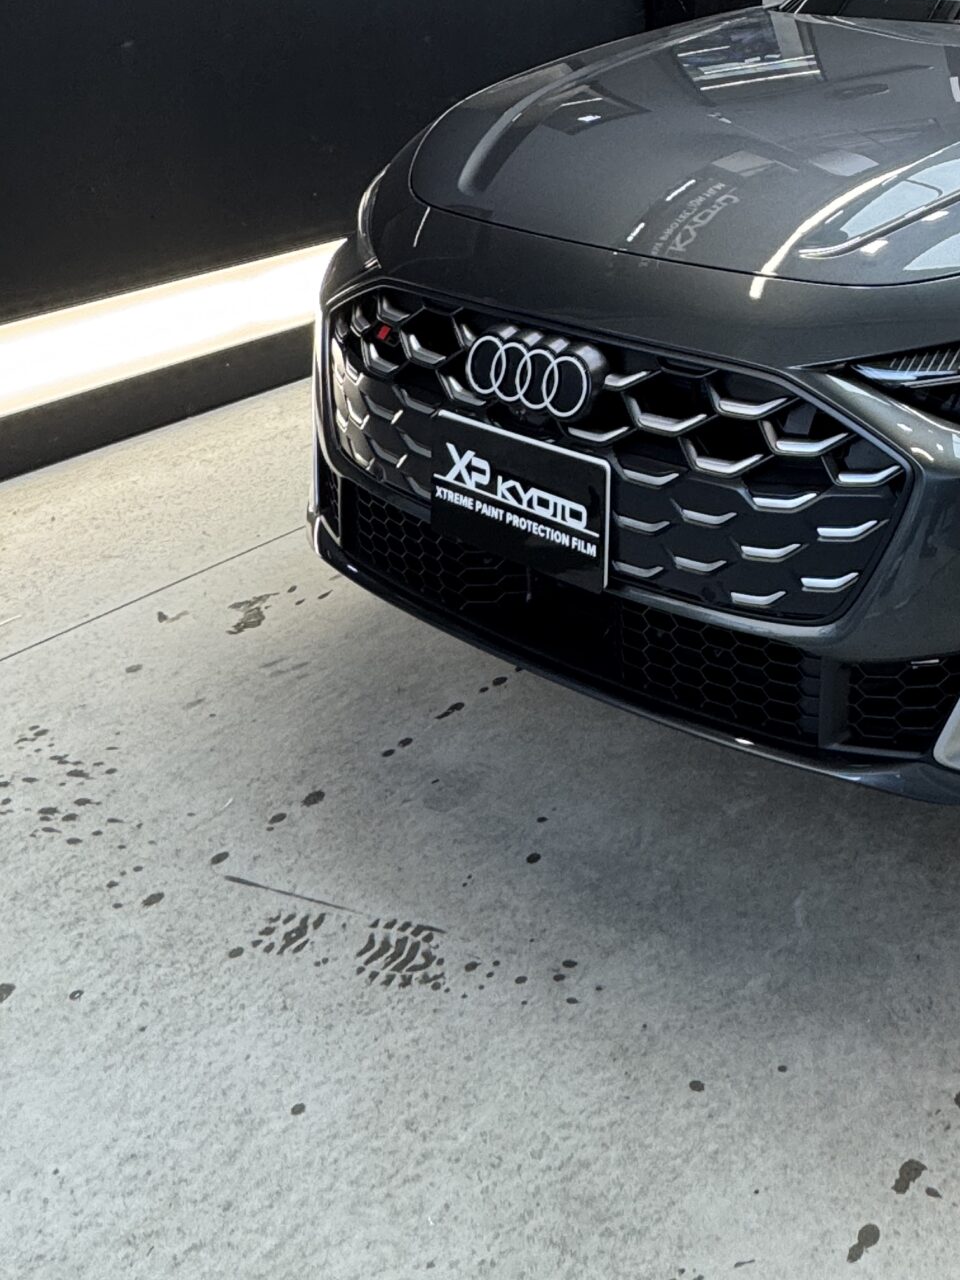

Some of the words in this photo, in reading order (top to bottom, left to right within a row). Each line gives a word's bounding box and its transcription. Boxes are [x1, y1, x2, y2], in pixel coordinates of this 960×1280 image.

[435, 486, 474, 510] XTREME
[475, 500, 504, 521] PAINT
[506, 512, 570, 547] PROTECTION
[571, 537, 597, 557] FILM
[497, 475, 587, 530] KYOTO
